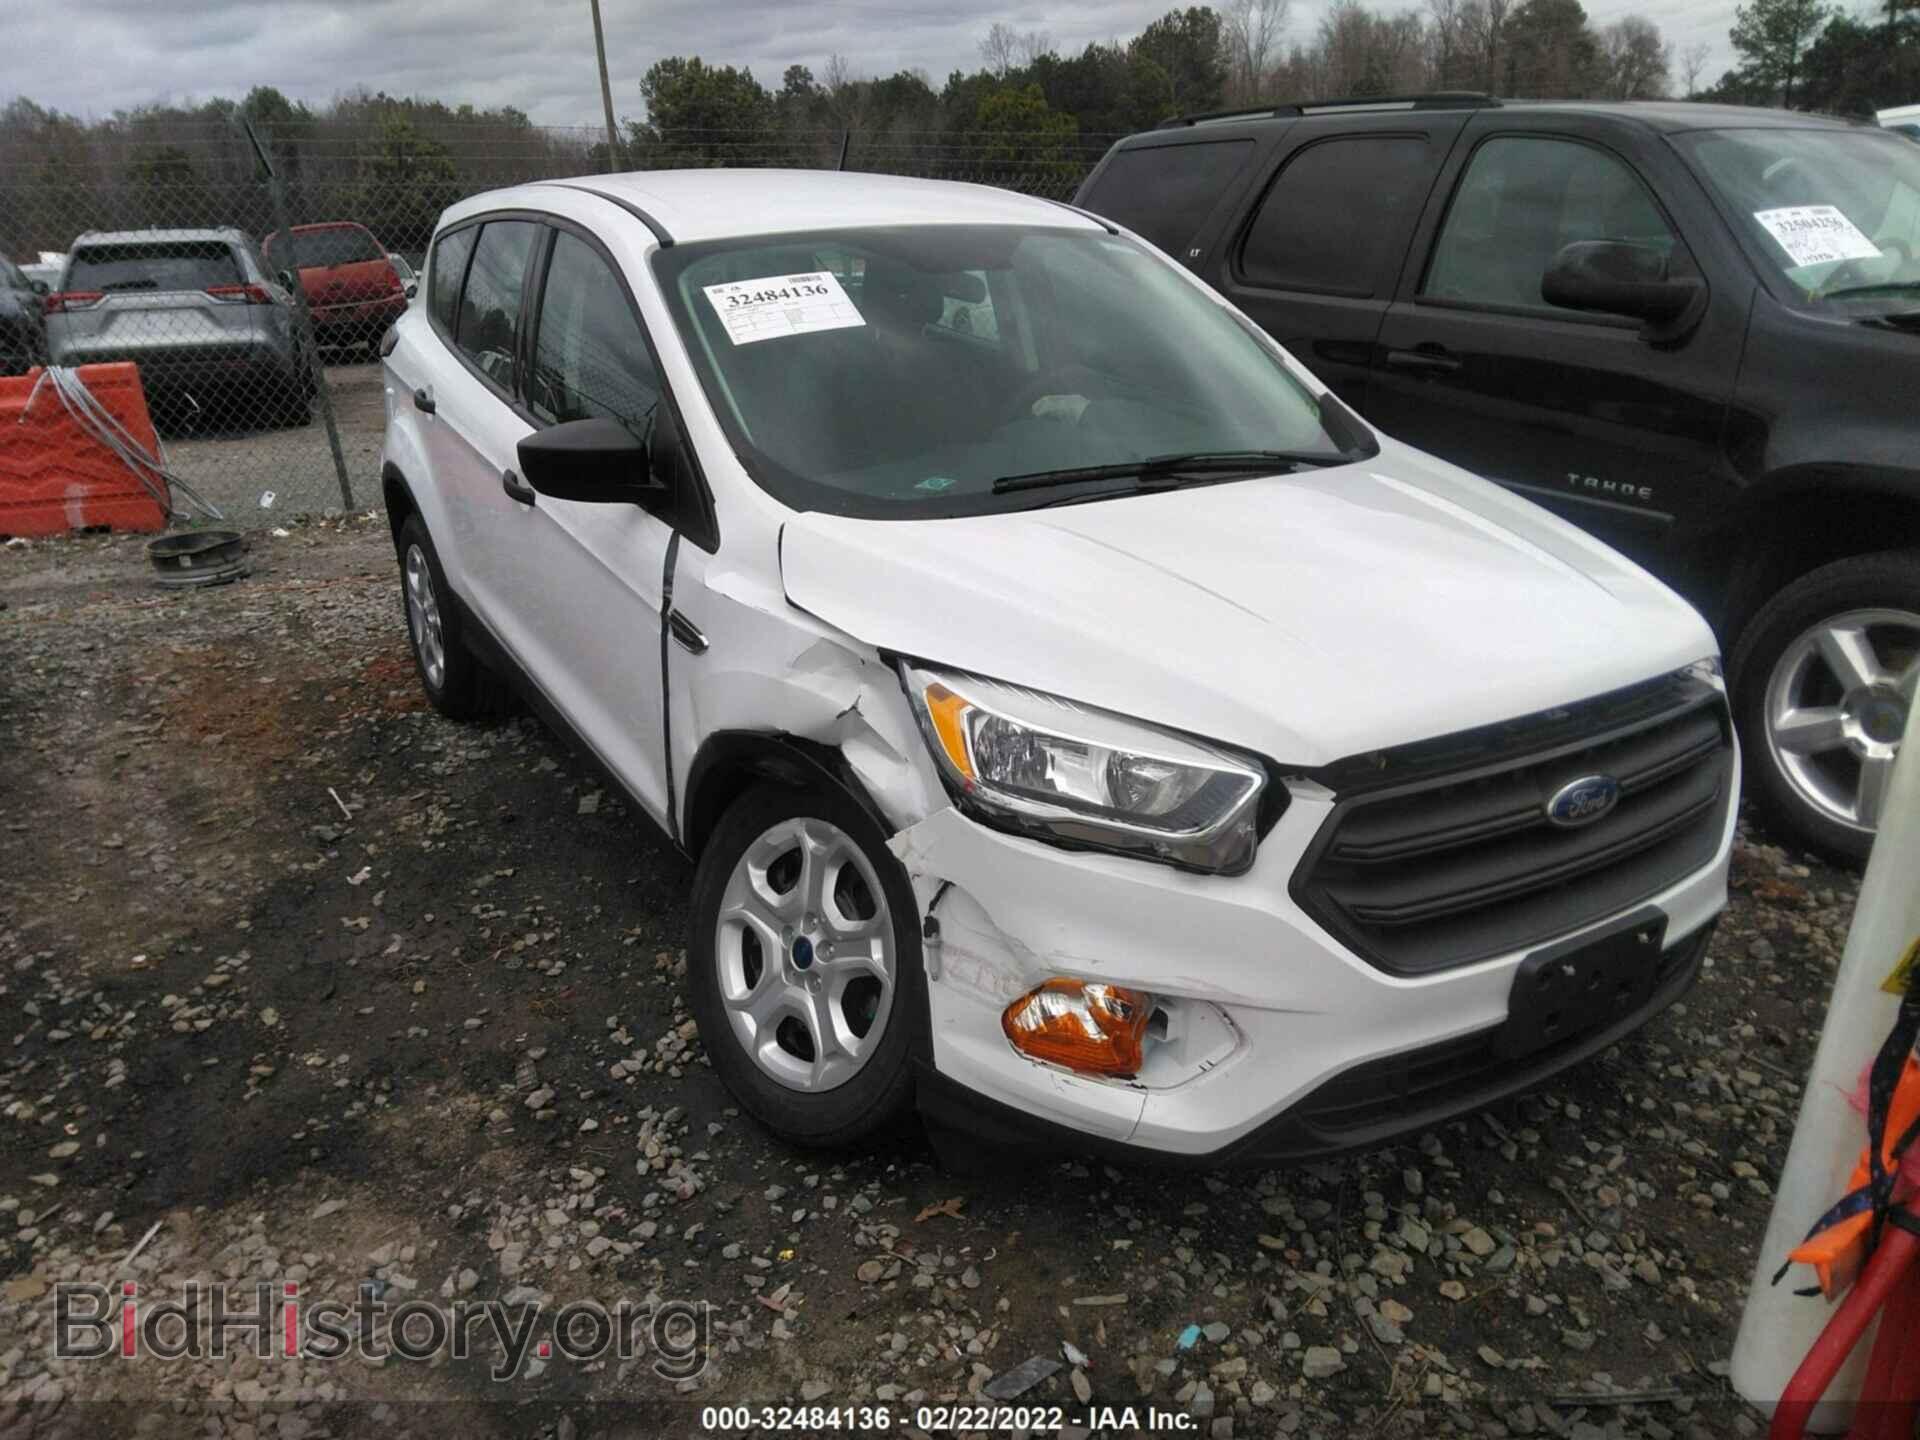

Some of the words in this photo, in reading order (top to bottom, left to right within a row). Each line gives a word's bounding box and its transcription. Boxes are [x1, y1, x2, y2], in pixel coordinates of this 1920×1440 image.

[726, 284, 829, 308] 32484136
[1567, 472, 1653, 499] TAHOE
[1567, 788, 1609, 817] Ford
